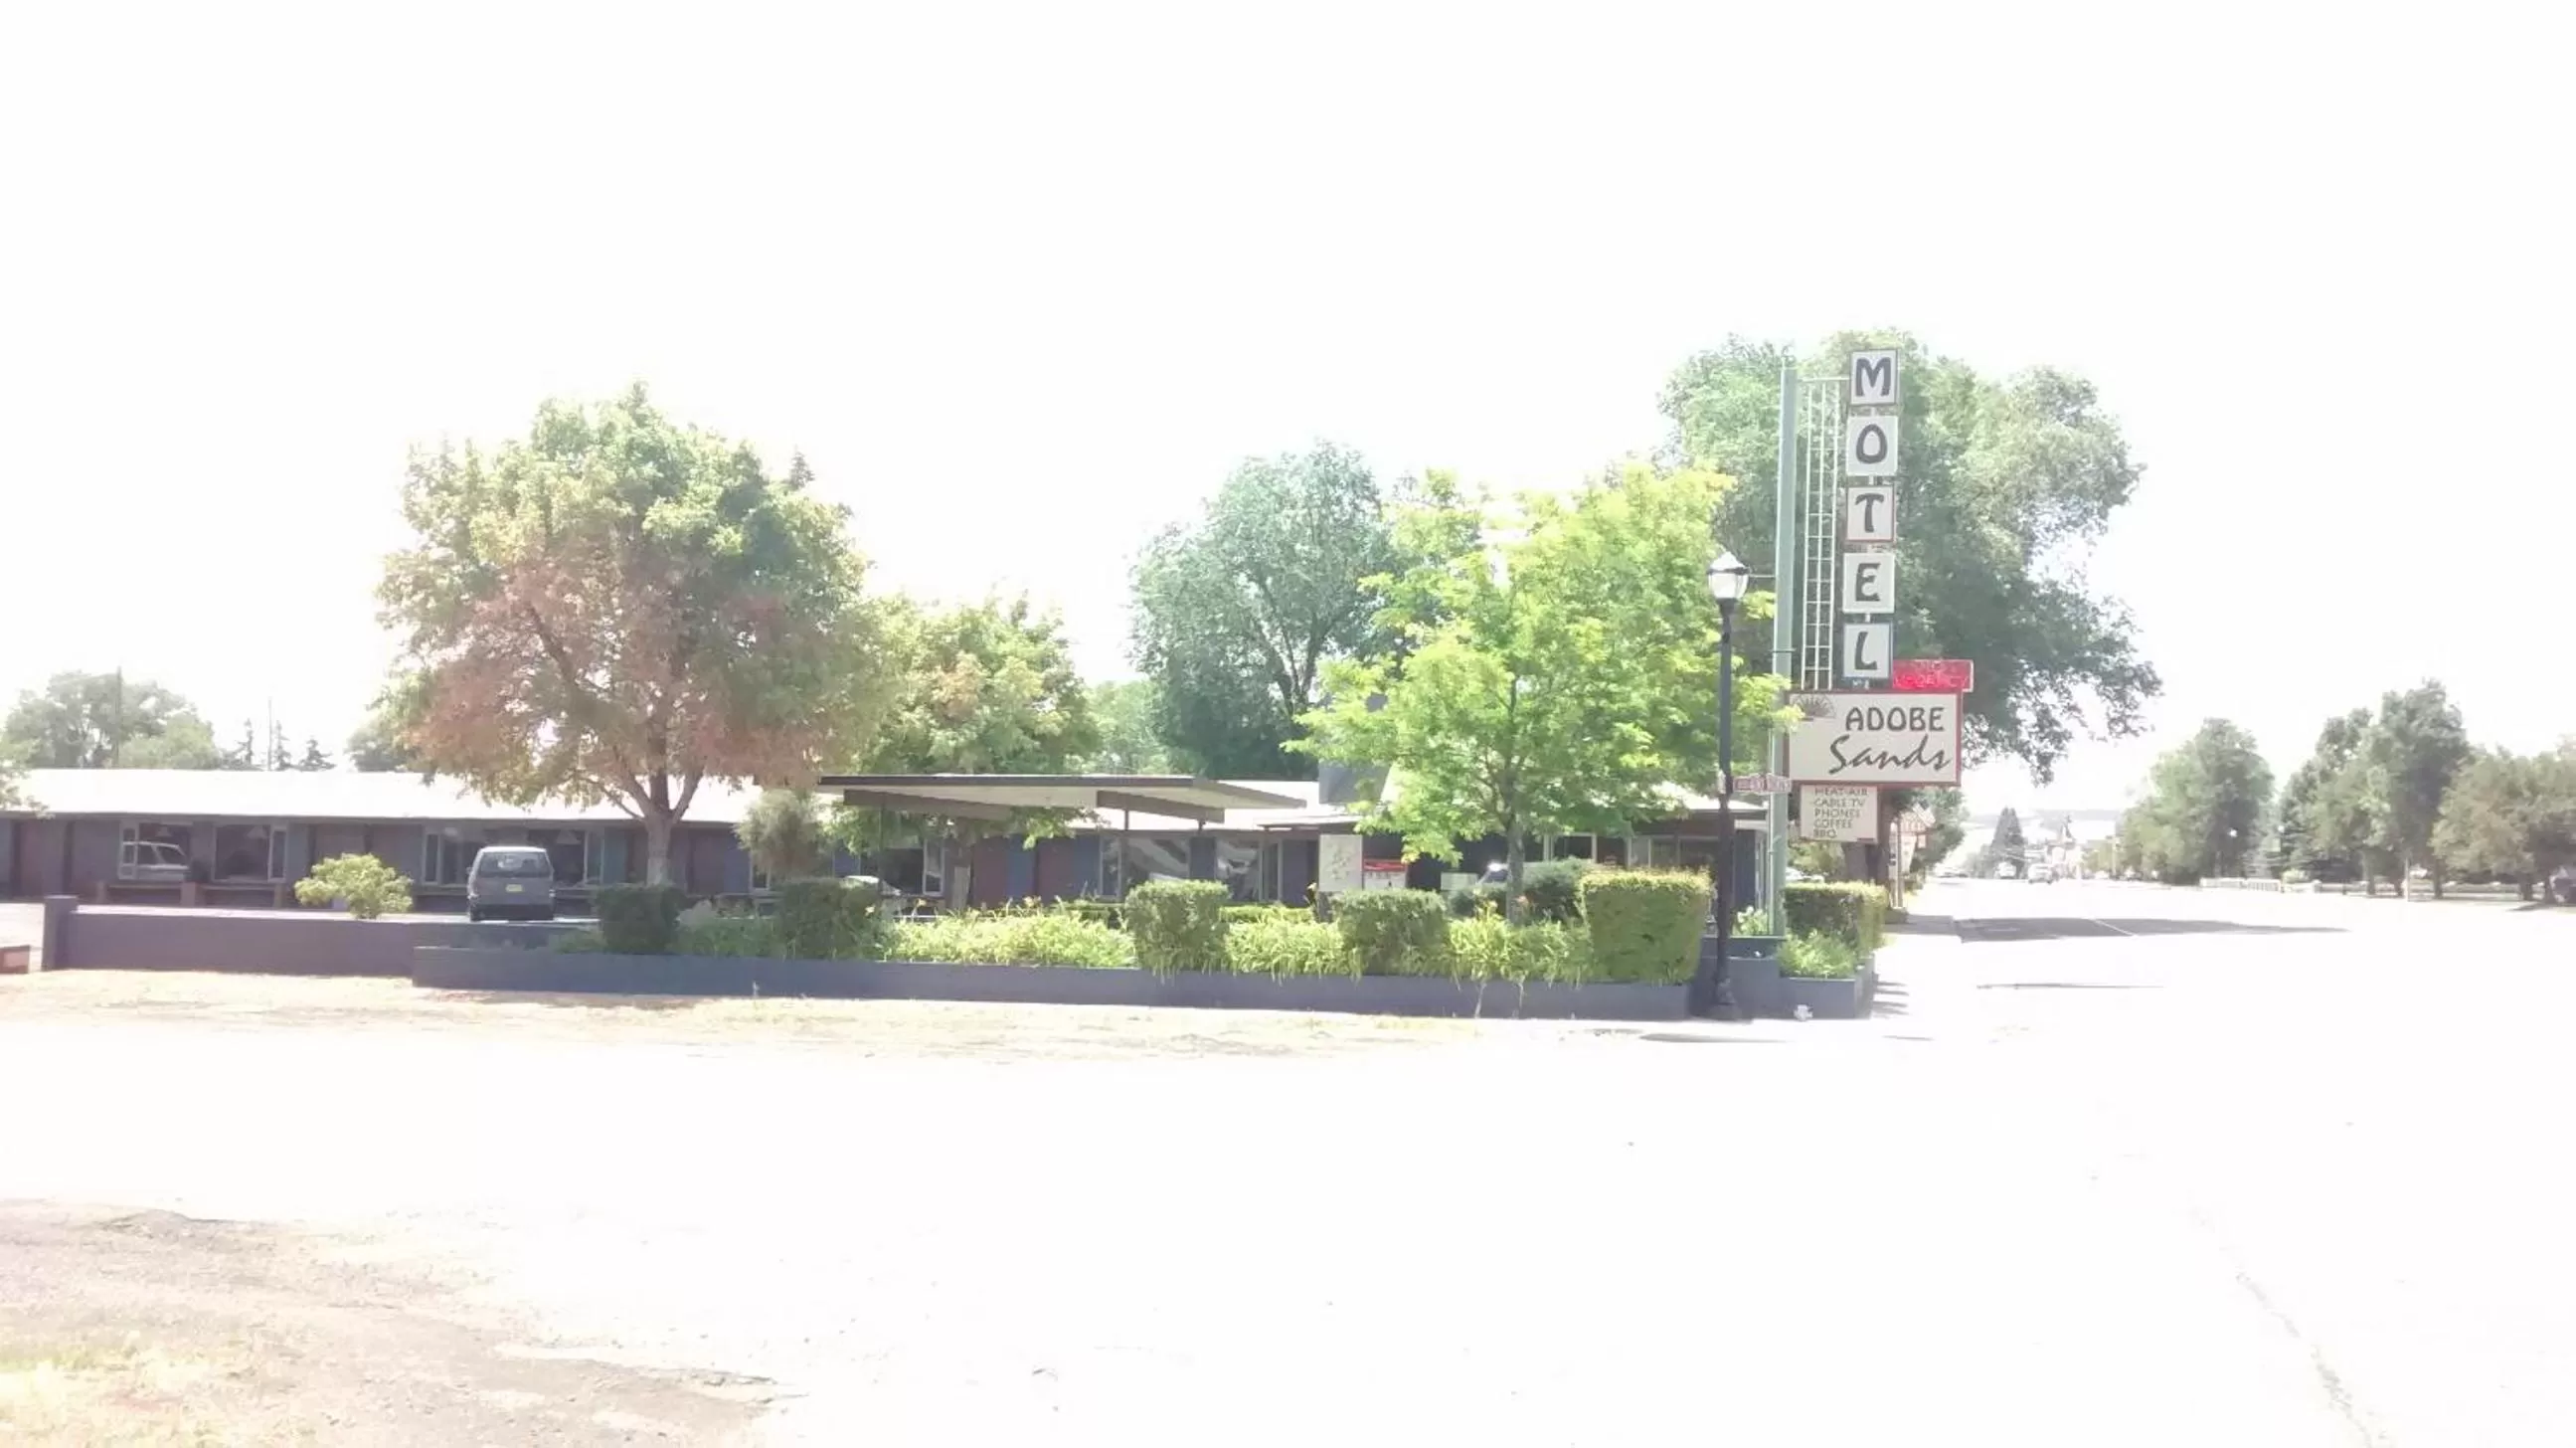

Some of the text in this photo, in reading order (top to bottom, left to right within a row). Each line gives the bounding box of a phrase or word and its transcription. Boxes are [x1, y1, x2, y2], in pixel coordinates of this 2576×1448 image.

[1854, 358, 1890, 671] MOTEL
[1845, 707, 1945, 731] ADOBE
[1828, 734, 1950, 774] Sands
[1813, 798, 1866, 808] CABLE TV
[1814, 809, 1860, 818] PHONES
[1813, 819, 1852, 828] COFFEE
[1813, 829, 1837, 839] BBQ
